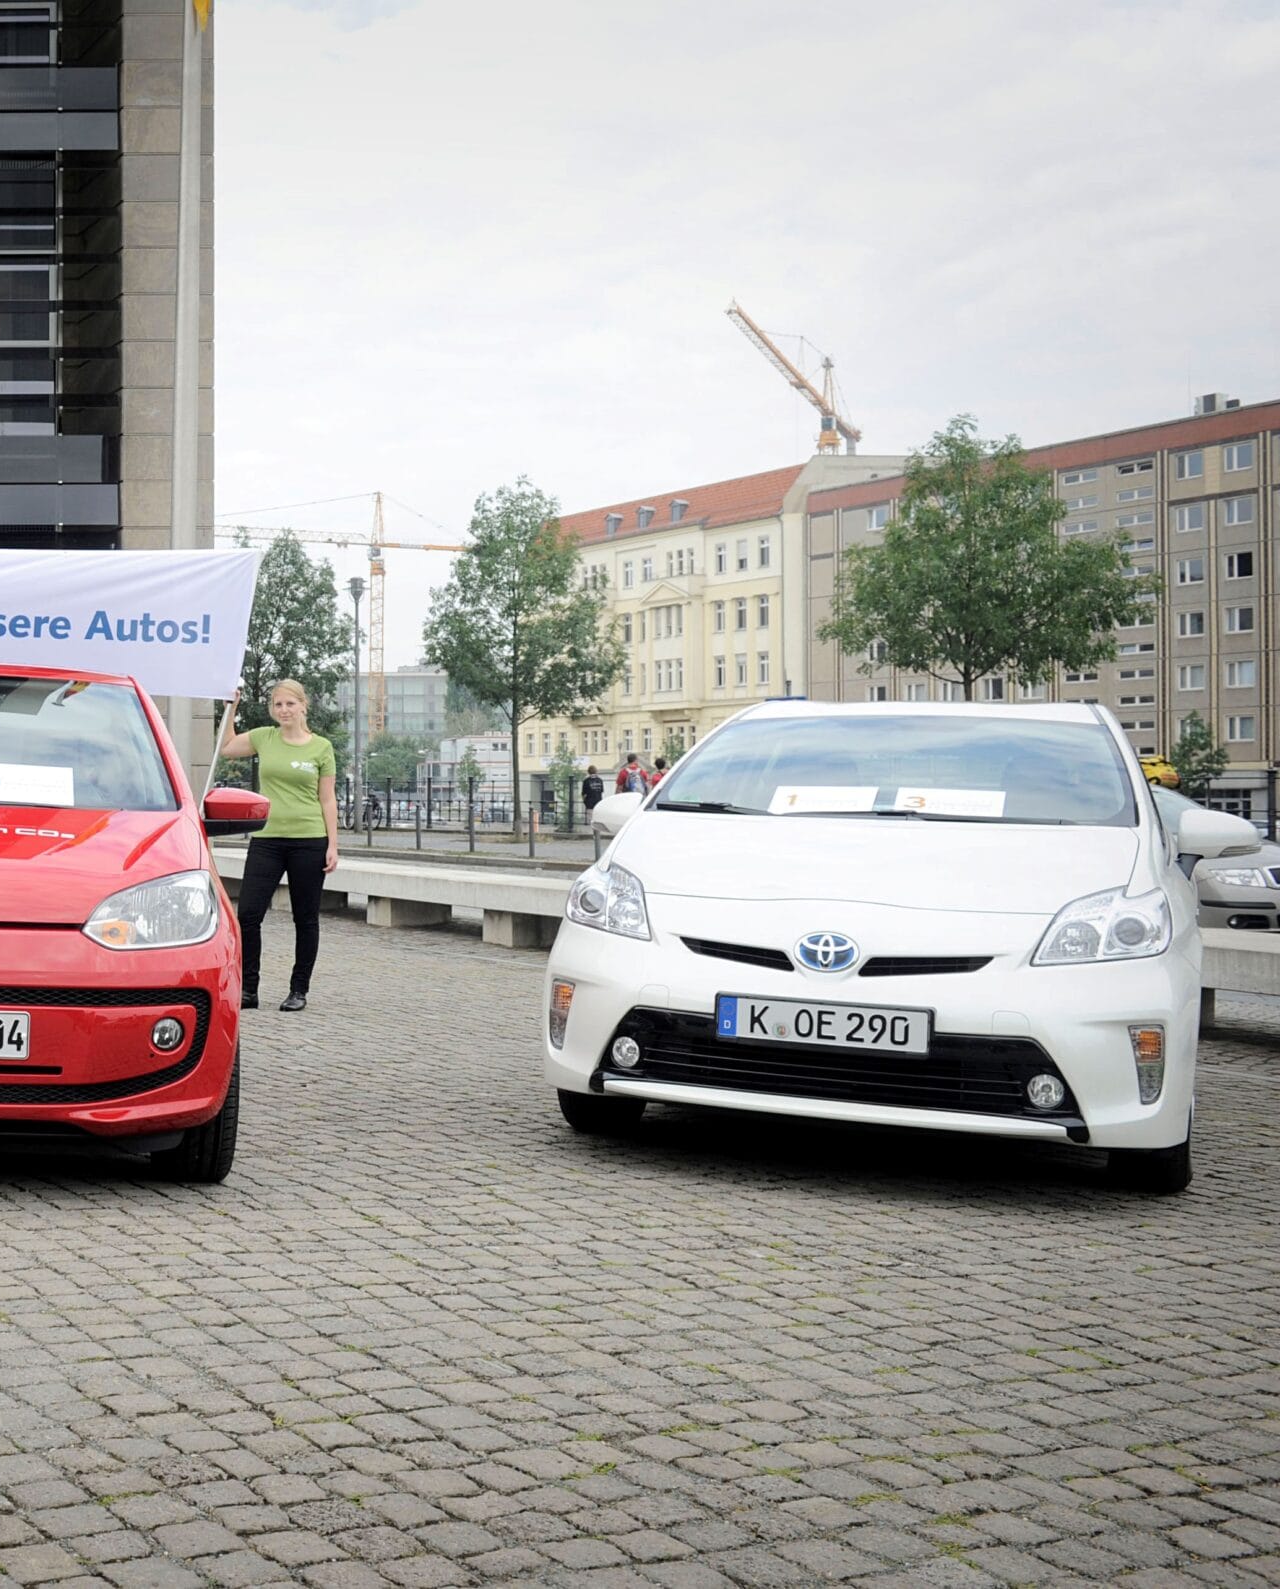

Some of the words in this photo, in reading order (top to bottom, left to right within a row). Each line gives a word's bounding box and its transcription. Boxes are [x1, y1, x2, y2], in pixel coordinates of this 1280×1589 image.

[84, 610, 212, 643] Autos!
[723, 1020, 731, 1029] D
[750, 1004, 770, 1035] K
[794, 1009, 837, 1041] OE
[845, 1013, 910, 1046] 290
